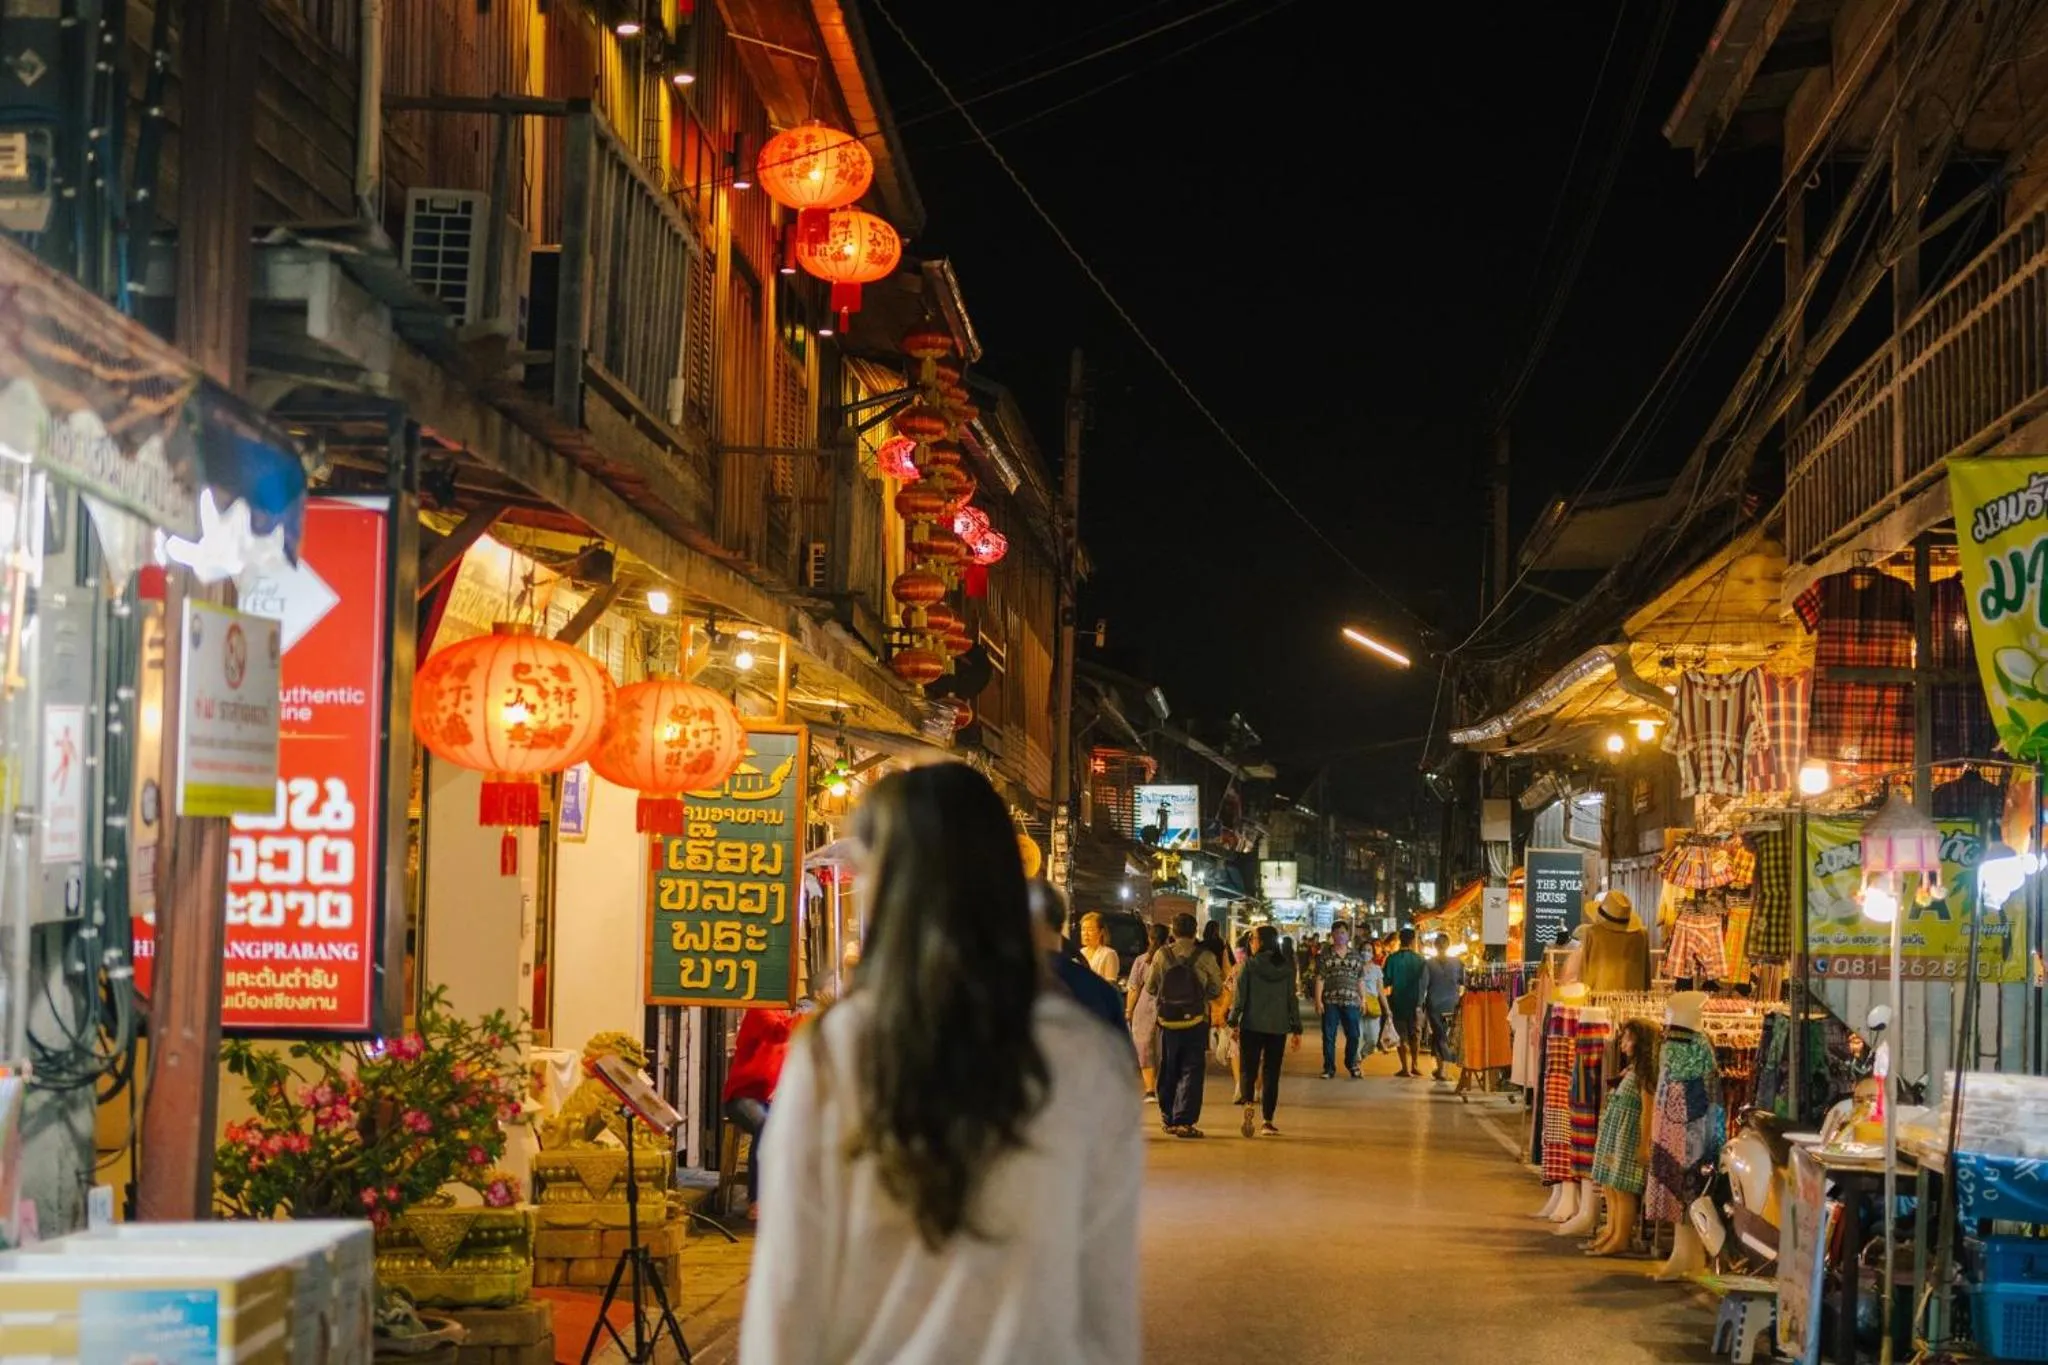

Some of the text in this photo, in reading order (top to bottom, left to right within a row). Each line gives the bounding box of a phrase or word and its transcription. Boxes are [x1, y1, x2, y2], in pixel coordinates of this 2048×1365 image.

[279, 685, 365, 705] uthentic
[1536, 879, 1557, 890] THE
[1536, 892, 1567, 903] HOUSE
[224, 941, 359, 961] NGPRABANG
